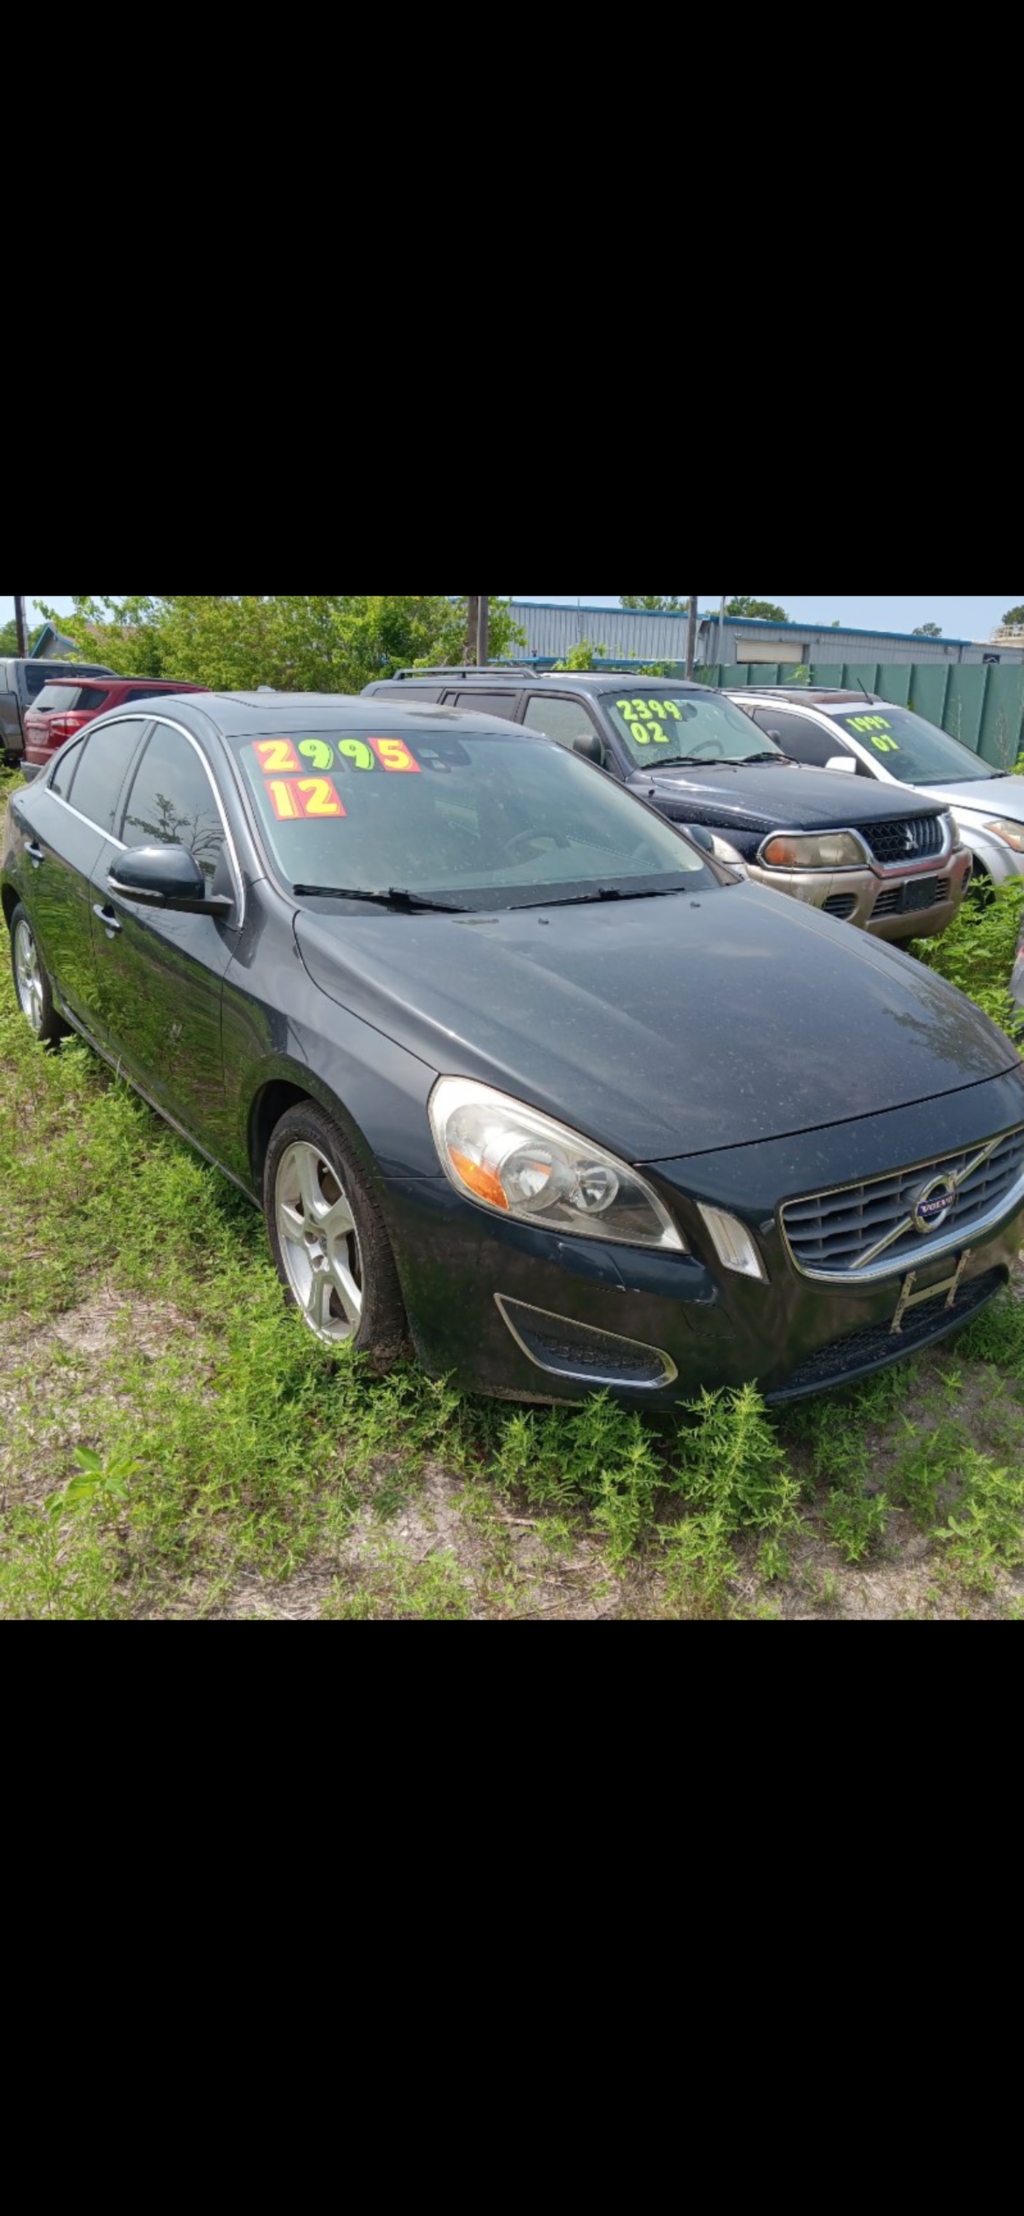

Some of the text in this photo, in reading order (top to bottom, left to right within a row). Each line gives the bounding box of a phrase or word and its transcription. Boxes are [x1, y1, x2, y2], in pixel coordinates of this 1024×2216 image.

[616, 699, 682, 720] 2399
[630, 722, 669, 744] 02
[846, 715, 892, 732] 1999
[871, 734, 900, 752] 07
[257, 738, 414, 771] 2995
[269, 777, 341, 818] 12
[920, 1195, 953, 1213] VOLVO
